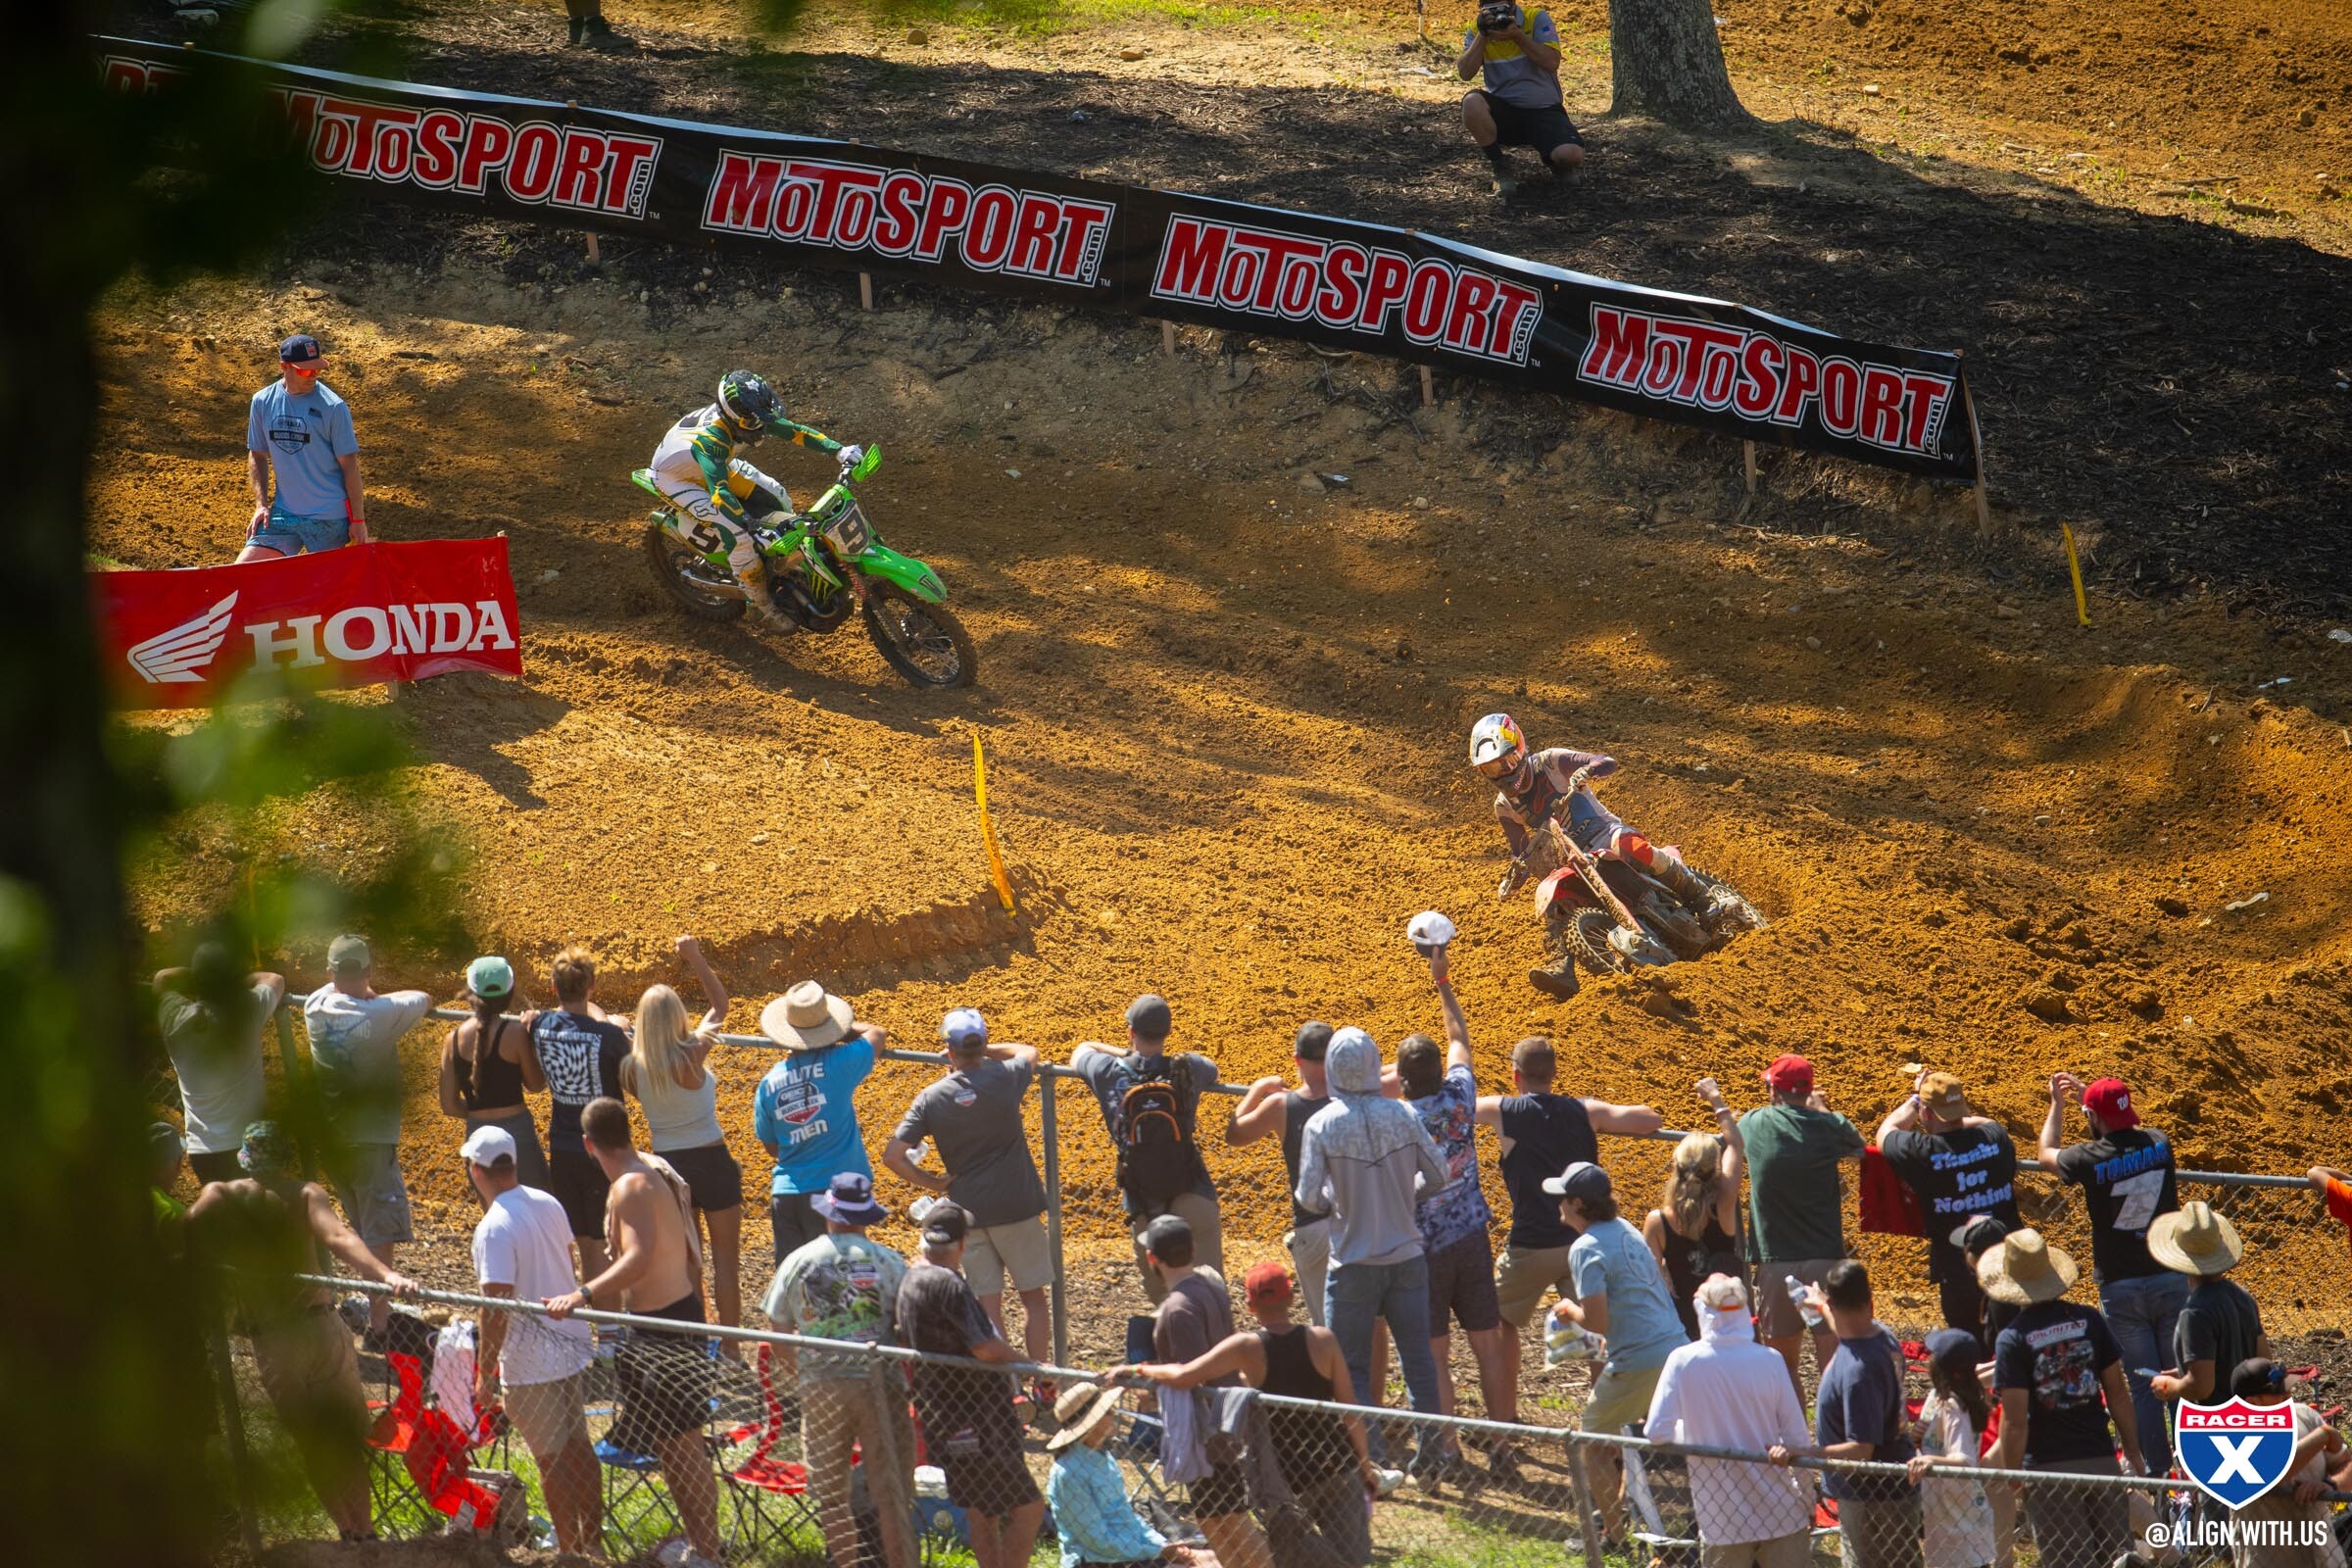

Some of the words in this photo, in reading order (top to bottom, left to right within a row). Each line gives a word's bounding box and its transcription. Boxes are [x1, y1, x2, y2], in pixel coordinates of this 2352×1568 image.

[705, 152, 1112, 284] MOTOSPORT
[1153, 216, 1542, 366] MOTOSPORT
[1578, 302, 1954, 457] MOTOSPORT
[838, 509, 865, 555] 9
[244, 600, 515, 674] HONDA
[765, 1062, 825, 1098] MINUTE
[1931, 1142, 2000, 1171] Thanks
[2093, 1141, 2170, 1185] TOMAC
[1934, 1183, 2012, 1213] Nothing
[1956, 1169, 1988, 1193] for
[2110, 1168, 2167, 1231] 7
